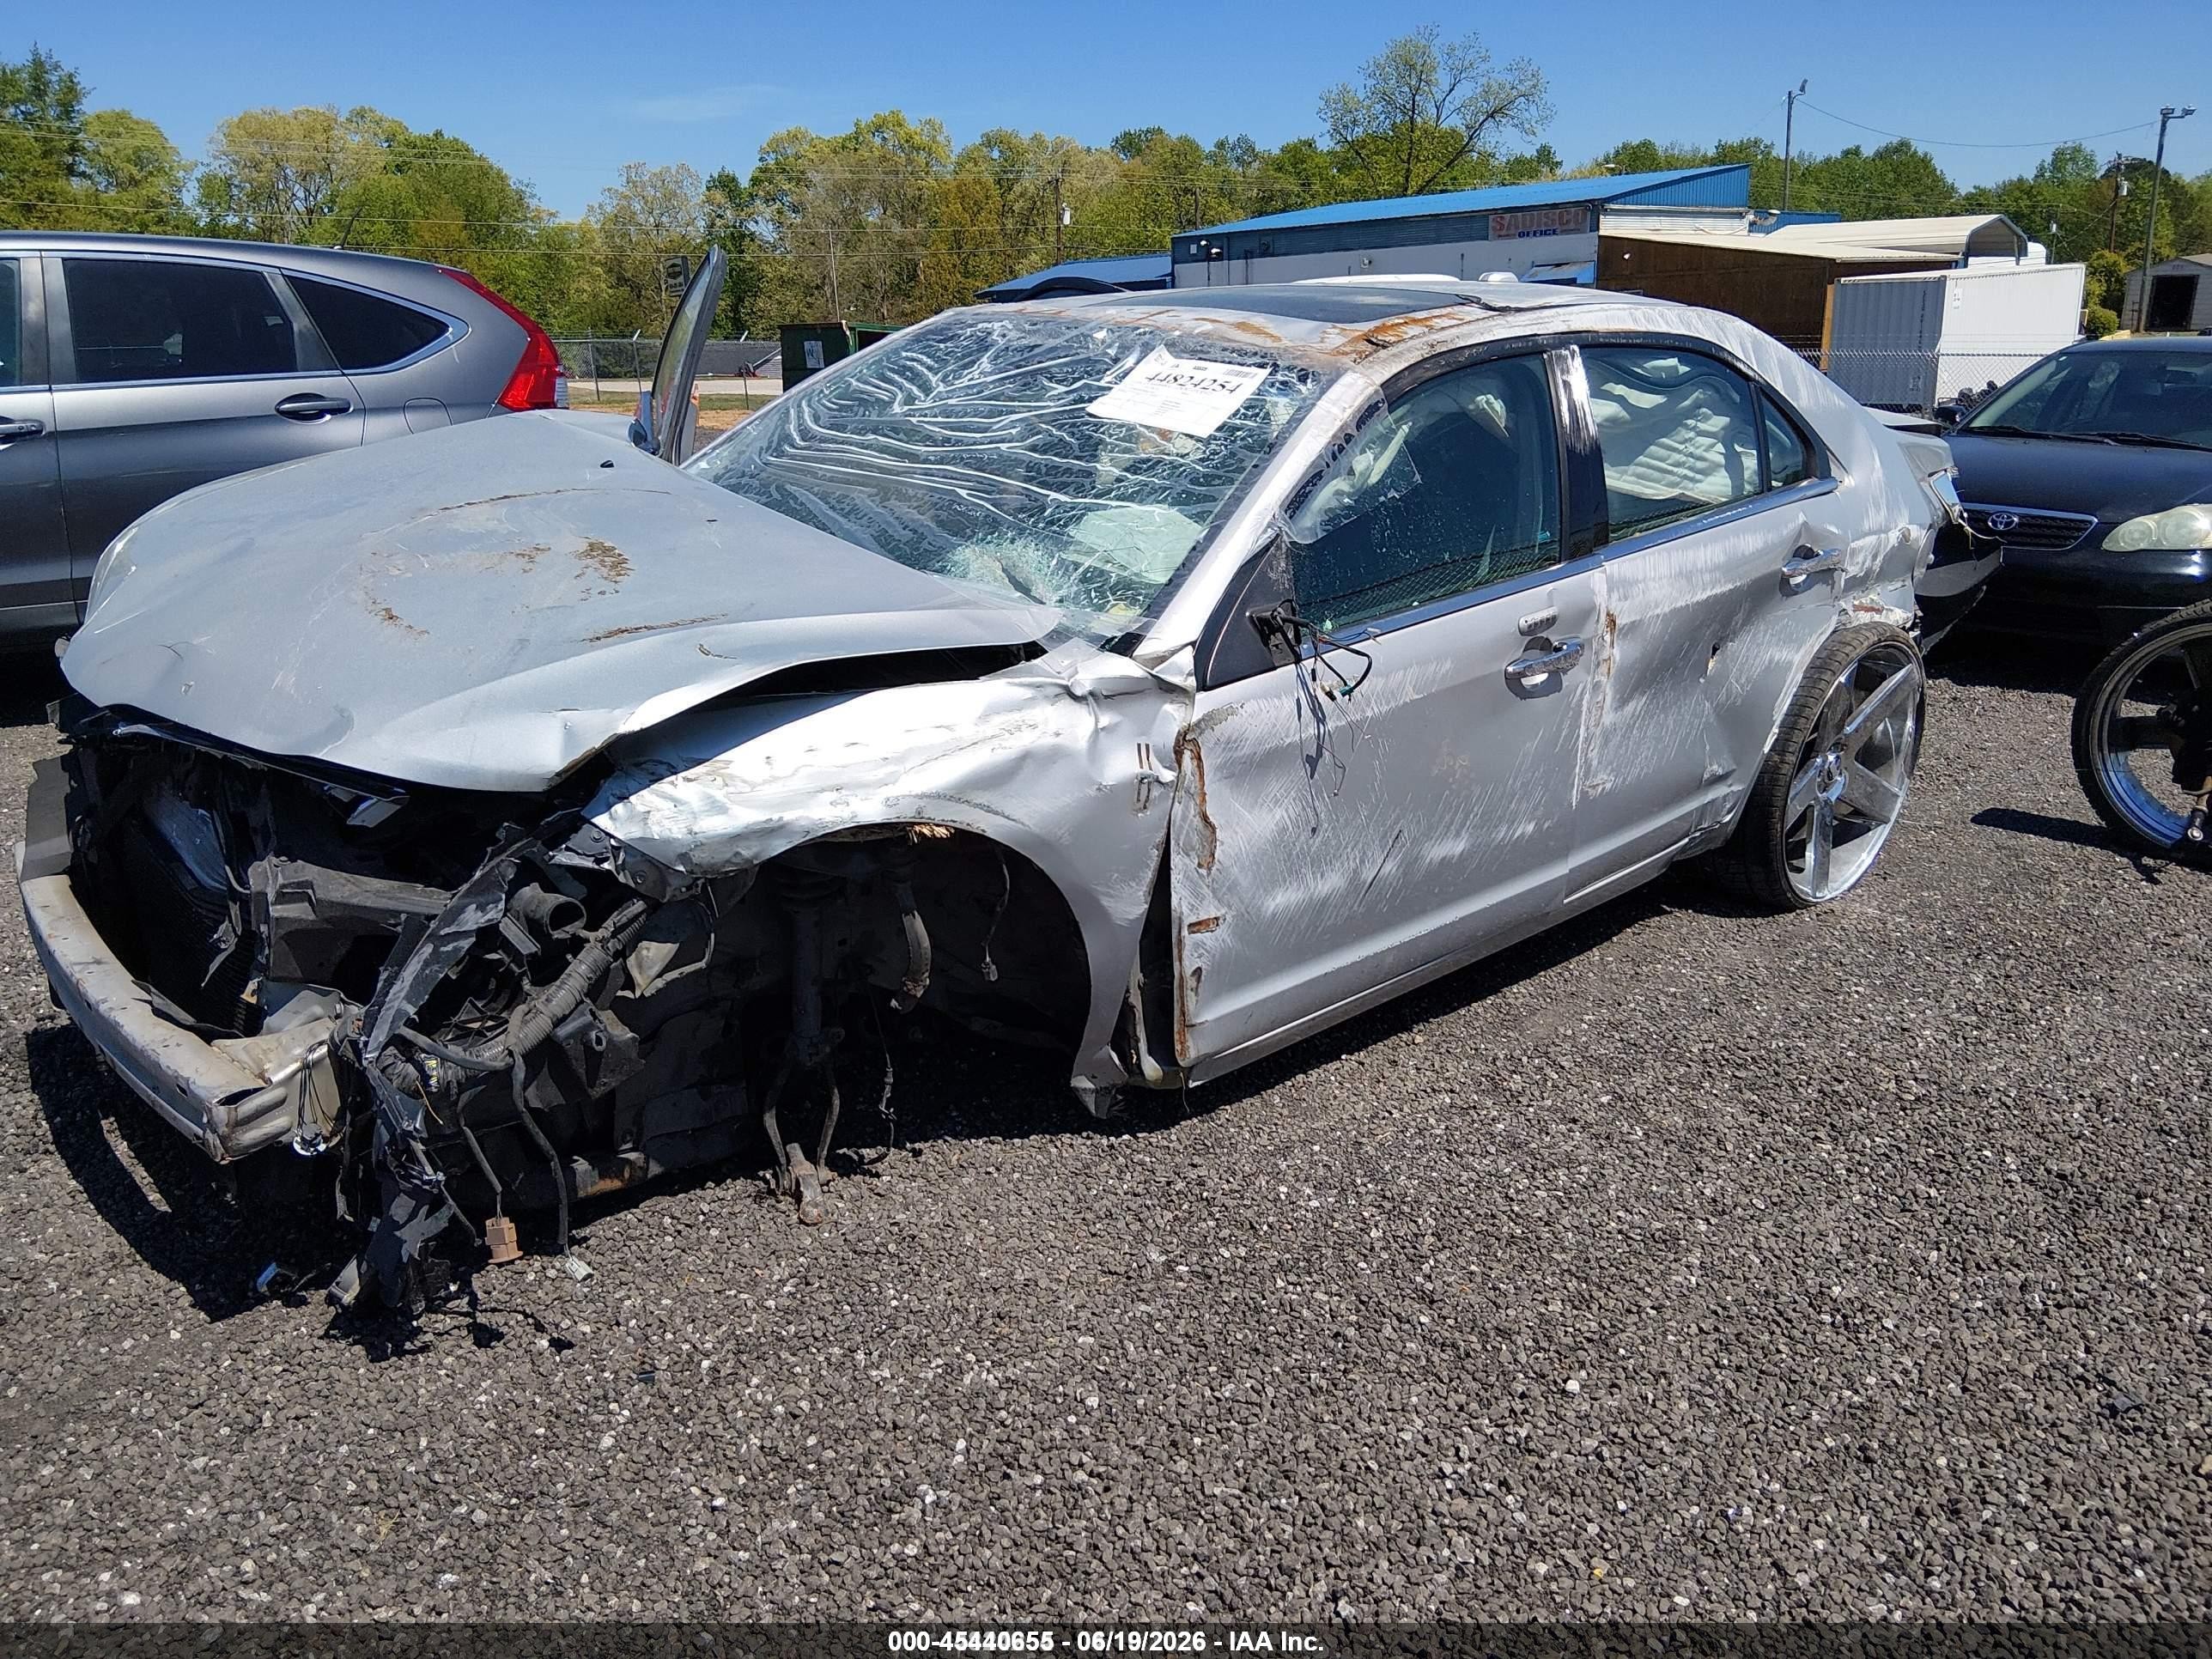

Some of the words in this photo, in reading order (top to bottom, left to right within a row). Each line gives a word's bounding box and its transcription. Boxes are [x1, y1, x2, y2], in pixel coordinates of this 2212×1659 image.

[1492, 208, 1587, 233] SADISCO
[1518, 228, 1559, 238] OFFICE
[1146, 373, 1243, 394] 44824254
